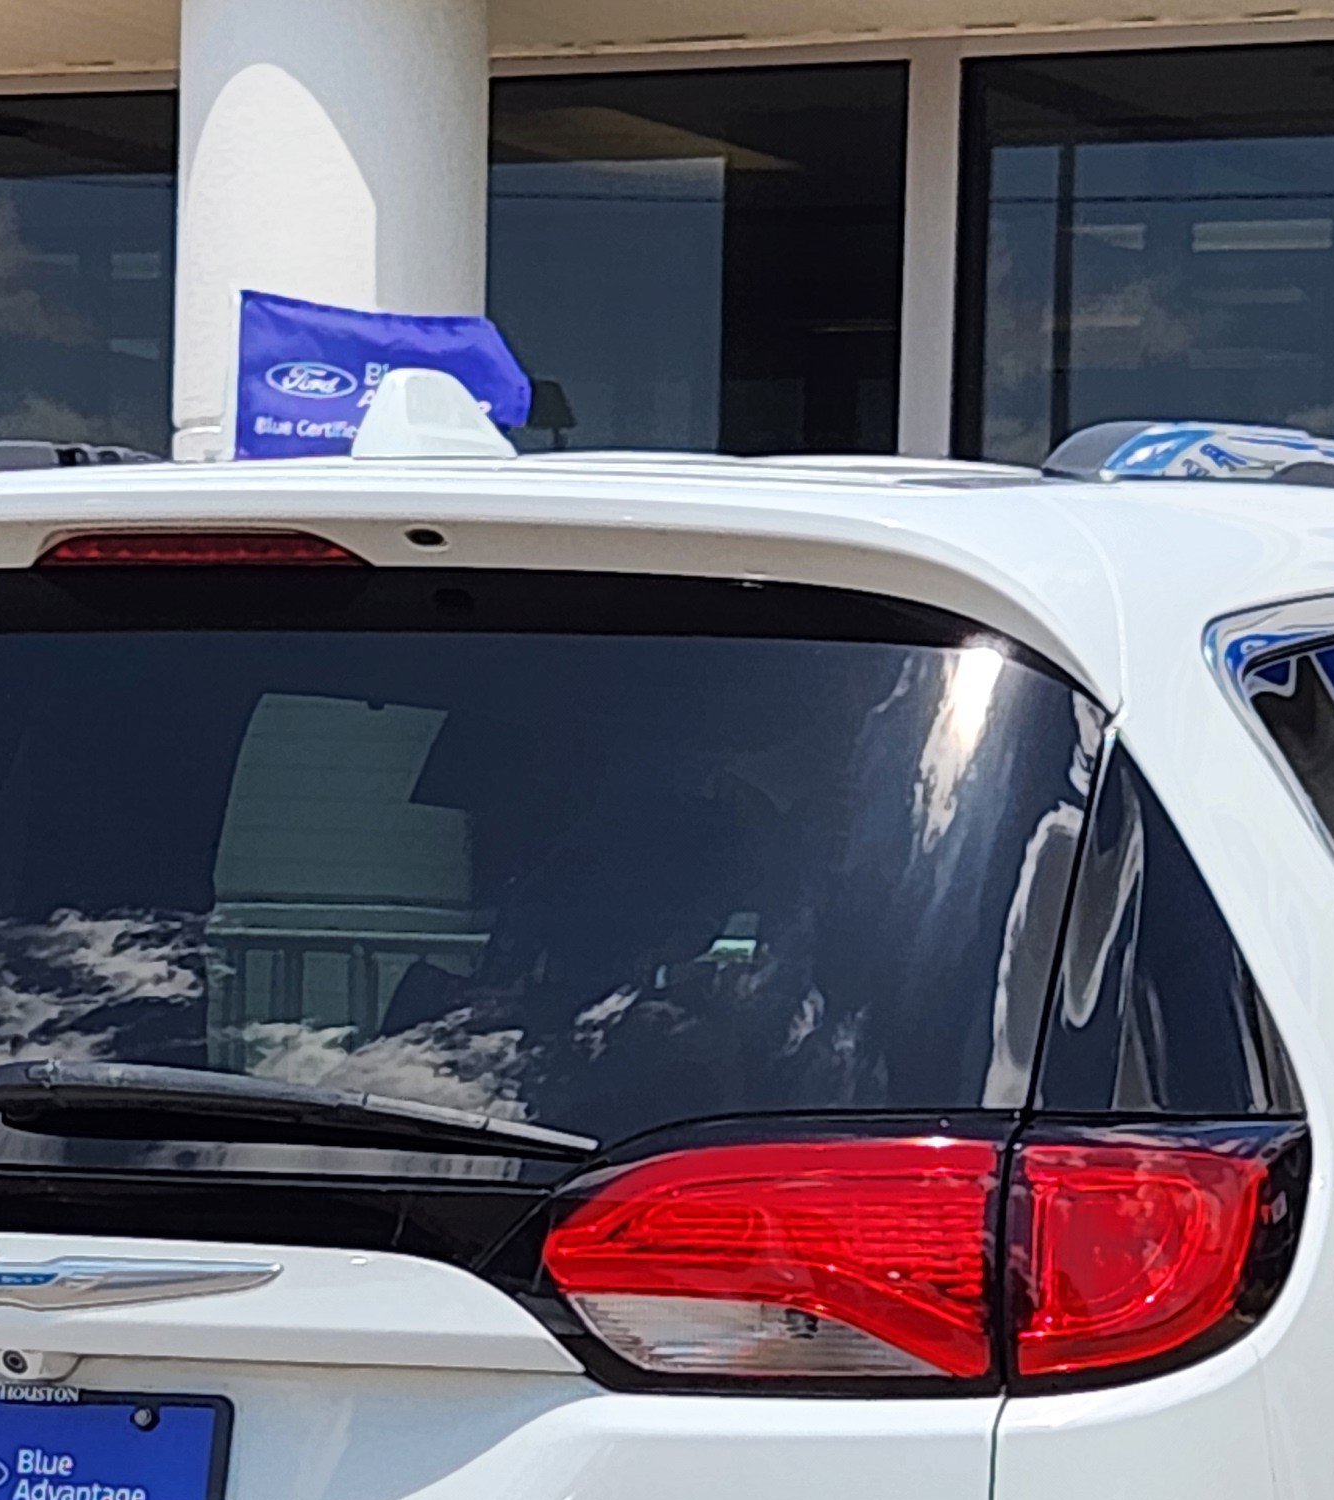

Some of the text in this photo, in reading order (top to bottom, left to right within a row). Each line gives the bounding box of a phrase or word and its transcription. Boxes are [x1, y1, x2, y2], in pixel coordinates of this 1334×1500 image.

[282, 366, 340, 394] Ford
[254, 416, 358, 438] Blue Certifie
[17, 1448, 74, 1476] Blue
